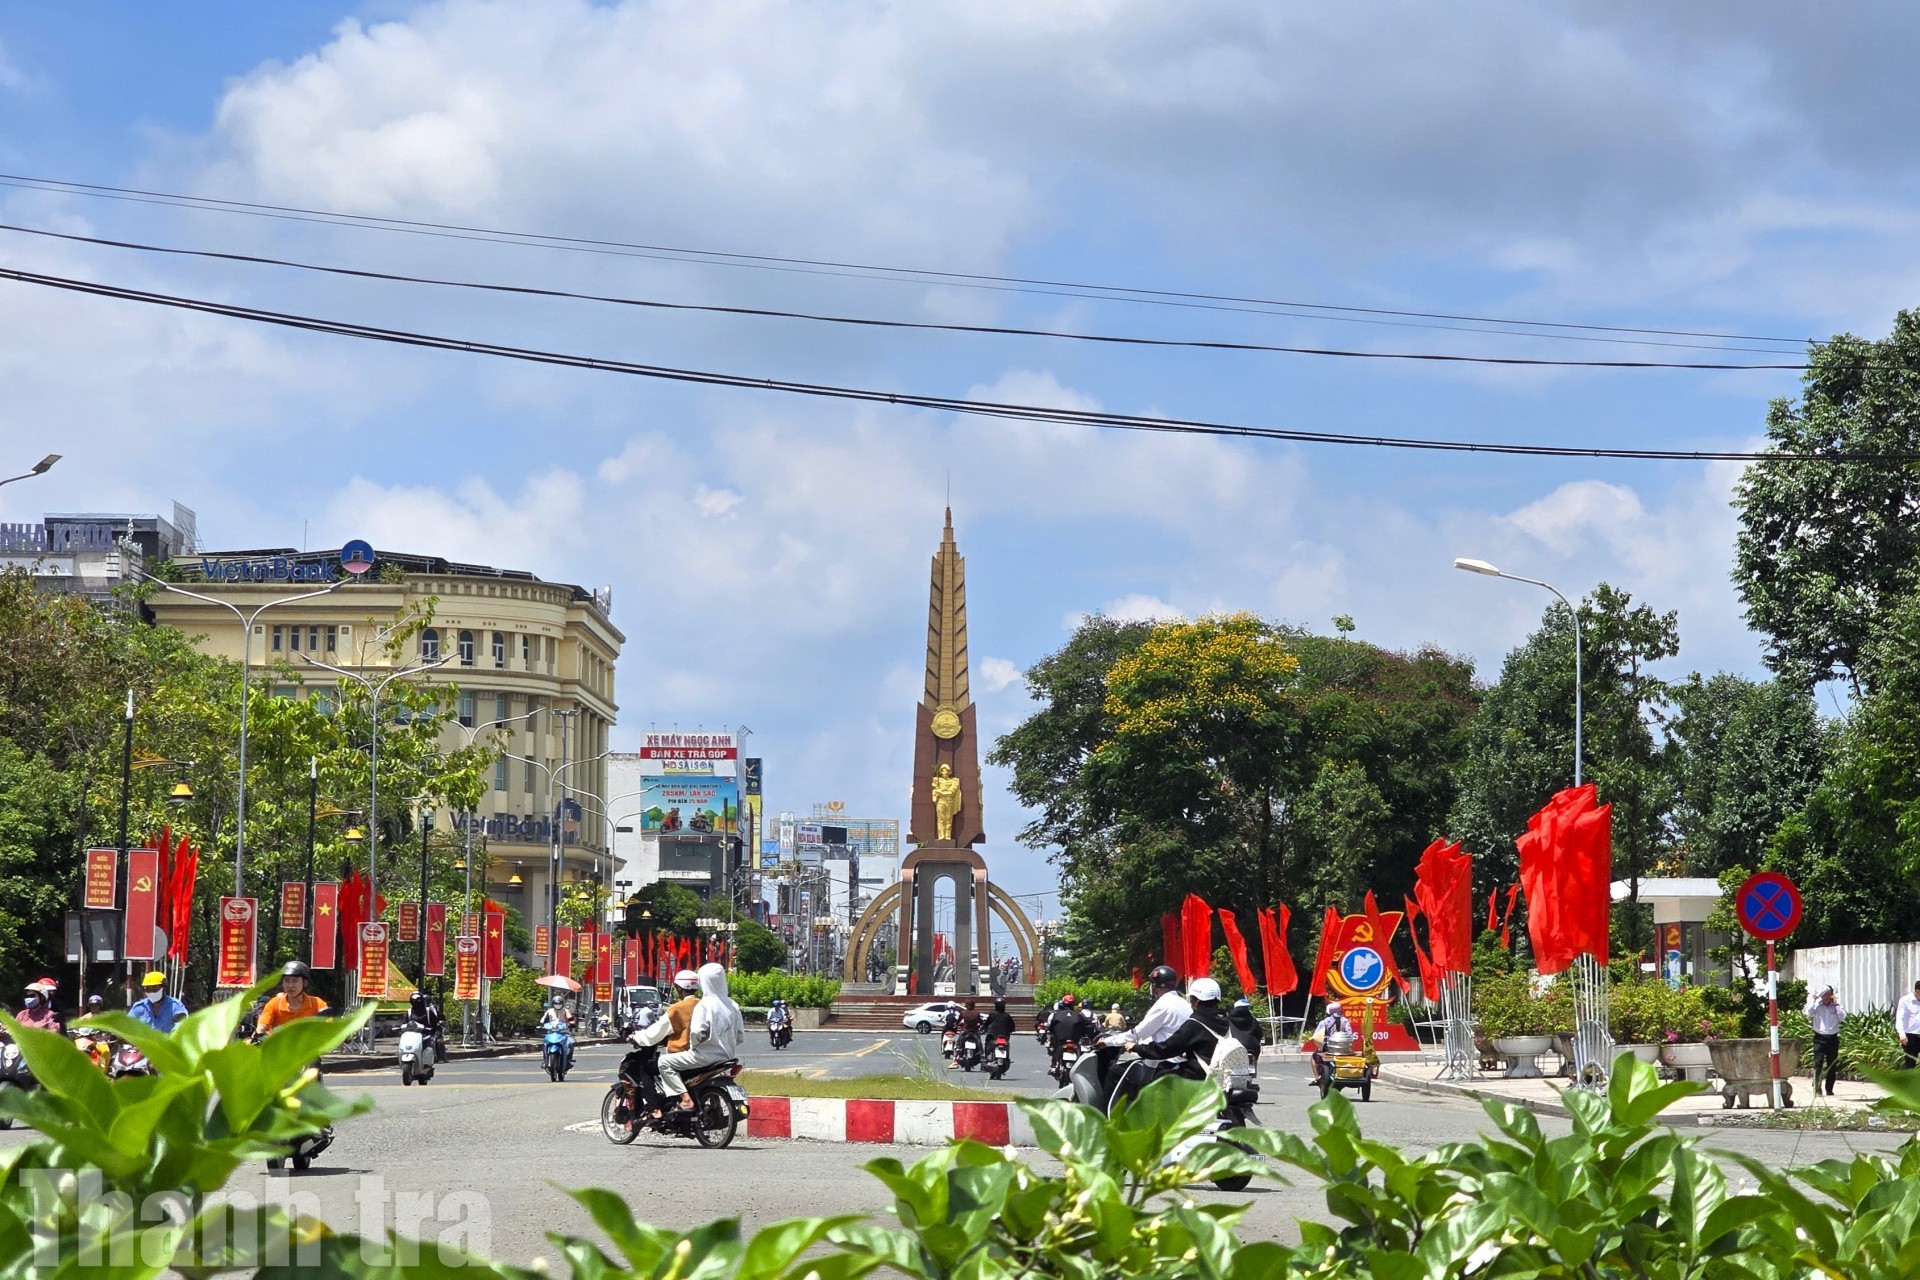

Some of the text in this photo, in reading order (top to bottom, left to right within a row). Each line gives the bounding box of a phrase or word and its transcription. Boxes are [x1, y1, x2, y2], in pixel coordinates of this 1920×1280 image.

[0, 523, 113, 552] NHA KHOA
[202, 556, 337, 580] VietinBank
[647, 733, 731, 748] XE MÁY NGỌC ANH
[650, 747, 727, 758] BÁN XE TRẢ GÓP
[663, 761, 714, 769] HD SAISON
